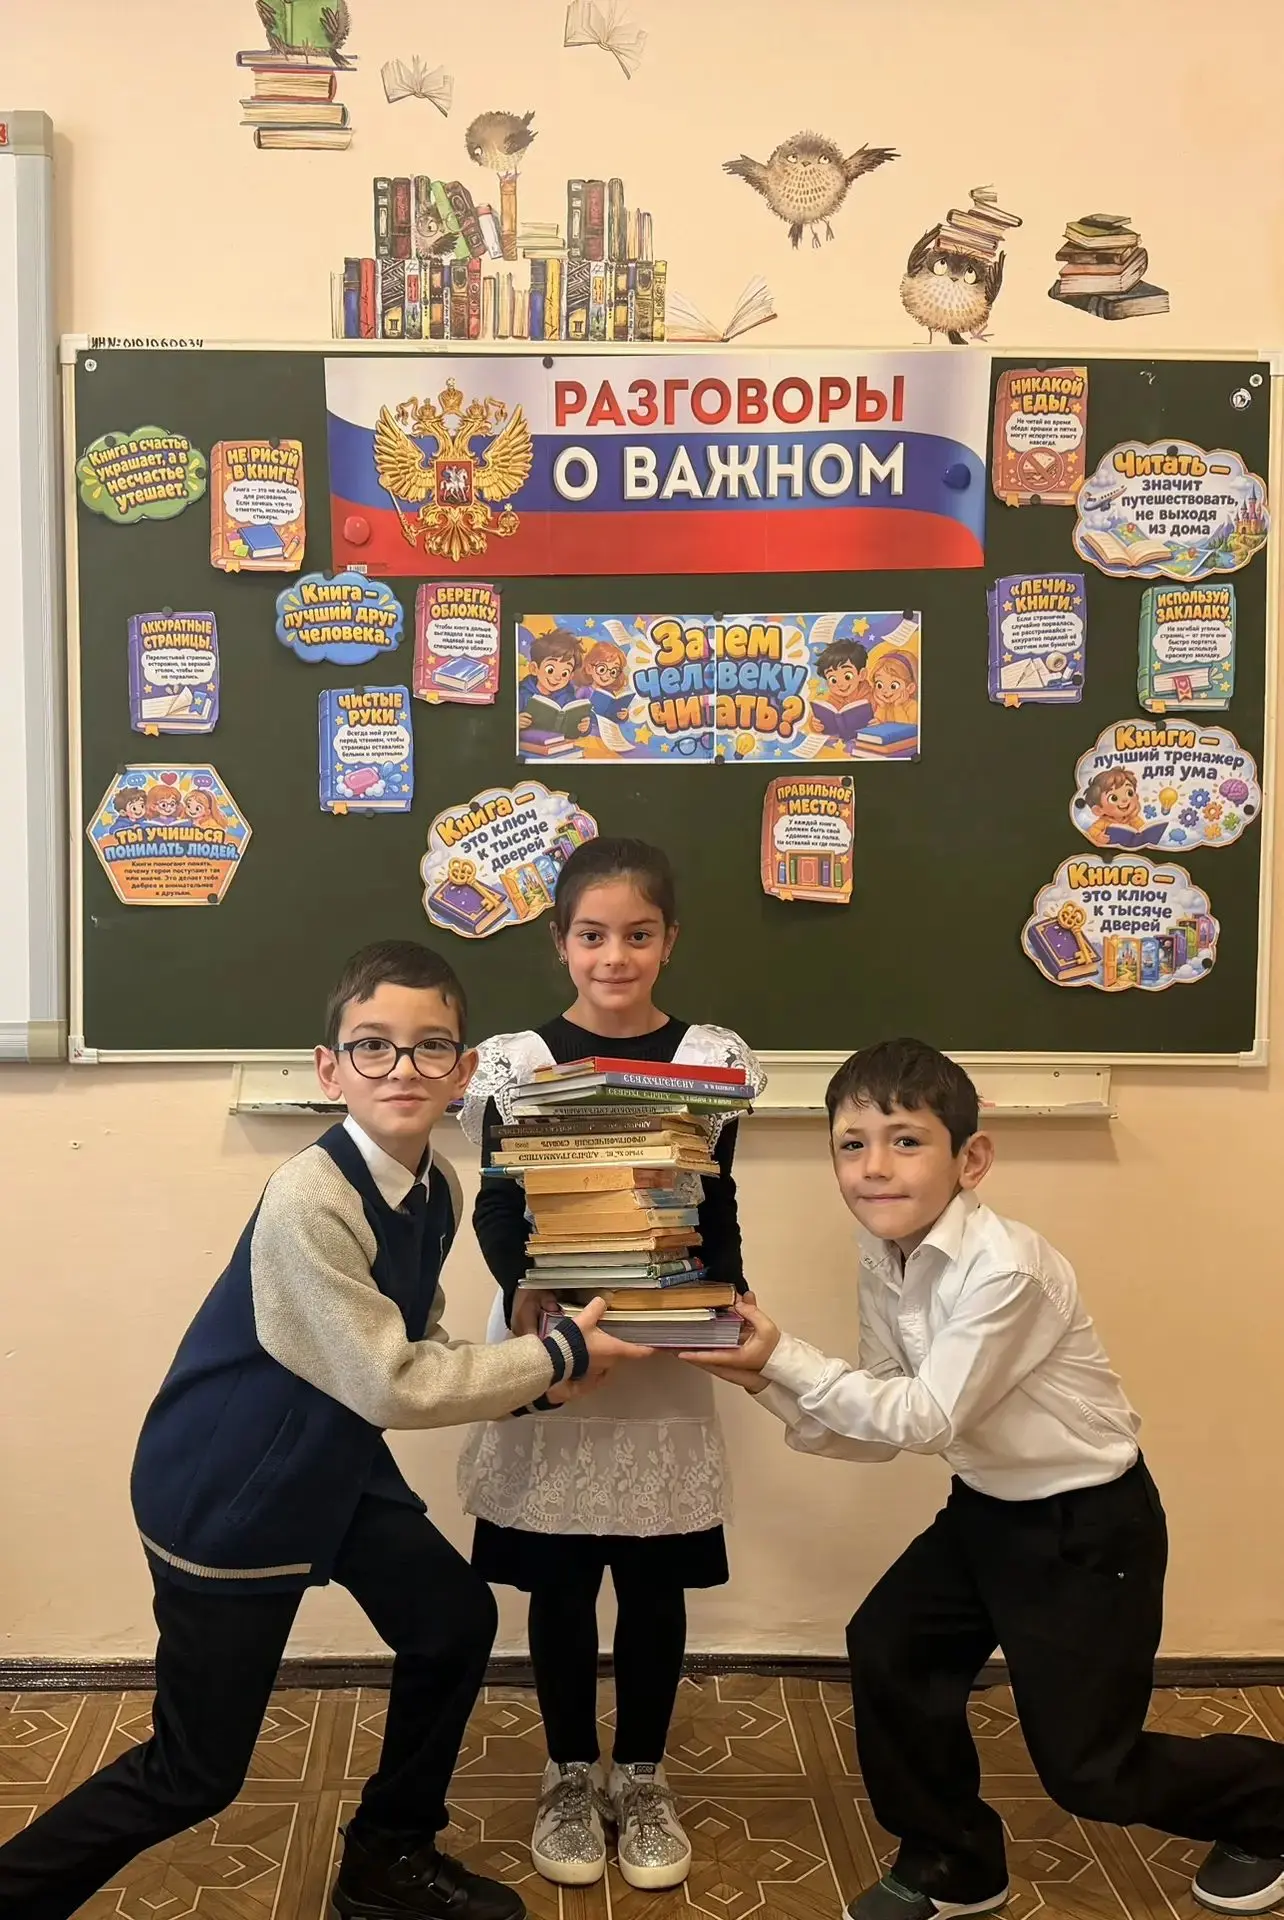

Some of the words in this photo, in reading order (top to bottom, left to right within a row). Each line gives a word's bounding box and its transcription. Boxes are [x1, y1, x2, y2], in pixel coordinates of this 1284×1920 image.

[1010, 376, 1084, 397] НИКАКОЙ
[554, 375, 905, 427] РАЗГОВОРЫ
[1022, 394, 1070, 414] ЕДЫ.
[88, 444, 128, 466] Книга
[129, 442, 137, 453] в
[139, 438, 189, 451] счастье
[226, 448, 247, 465] НЕ
[250, 447, 299, 468] РИСУЙ
[96, 453, 166, 480] украшает,
[168, 452, 176, 464] а
[179, 452, 187, 463] в
[553, 445, 598, 501] О
[623, 441, 905, 500] ВАЖНОМ
[1113, 450, 1207, 478] Читать
[106, 466, 185, 494] несчастье
[233, 464, 245, 480] В
[247, 463, 298, 485] КНИГЕ.
[1142, 479, 1202, 491] значит
[116, 483, 187, 513] утешает.
[1122, 494, 1238, 508] путешествовать,
[1136, 510, 1153, 521] не
[1159, 509, 1217, 522] выходя
[1149, 525, 1166, 534] из
[1170, 524, 1210, 537] дома
[301, 583, 362, 604] Книга
[437, 588, 491, 604] БЕРЕГИ
[1010, 579, 1076, 595] «ЛЕЧИ»
[1015, 595, 1073, 614] КНИГИ.
[1157, 588, 1229, 606] ИСПОЛЬЗУЙ
[285, 601, 352, 628] лучший
[355, 607, 397, 626] друг
[431, 604, 497, 622] ОБЛОЖКУ.
[1157, 605, 1231, 623] ЗАКЛАДКУ.
[141, 619, 212, 634] АККУРАТНЫЕ
[299, 626, 391, 644] человека.
[143, 634, 213, 650] СТРАНИЦЫ.
[338, 693, 403, 709] ЧИСТЫЕ
[348, 709, 398, 726] РУКИ.
[1114, 725, 1196, 750] Книги
[1093, 749, 1160, 769] лучший
[1164, 750, 1245, 770] тренажер
[1142, 766, 1175, 780] для
[1180, 766, 1218, 781] ума
[777, 784, 852, 803] ПРАВИЛЬНОЕ
[789, 799, 840, 816] МЕСТО.
[436, 796, 513, 847] Книга
[116, 827, 143, 843] ТЫ
[146, 826, 224, 842] УЧИШЬСЯ
[461, 831, 488, 853] это
[492, 809, 538, 837] ключ
[477, 850, 488, 861] к
[490, 820, 549, 850] тысяче
[105, 842, 184, 860] ПОНИМАТЬ
[188, 842, 239, 860] ЛЮДЕЙ.
[491, 836, 545, 872] дверей
[1068, 861, 1149, 890] Книга
[1082, 890, 1111, 903] это
[1117, 890, 1167, 903] ключ
[1094, 906, 1104, 916] к
[1109, 906, 1172, 918] тысяче
[1100, 919, 1160, 934] дверей
[574, 1136, 646, 1147] ОРФОГРАФИЧЕСКИЙ
